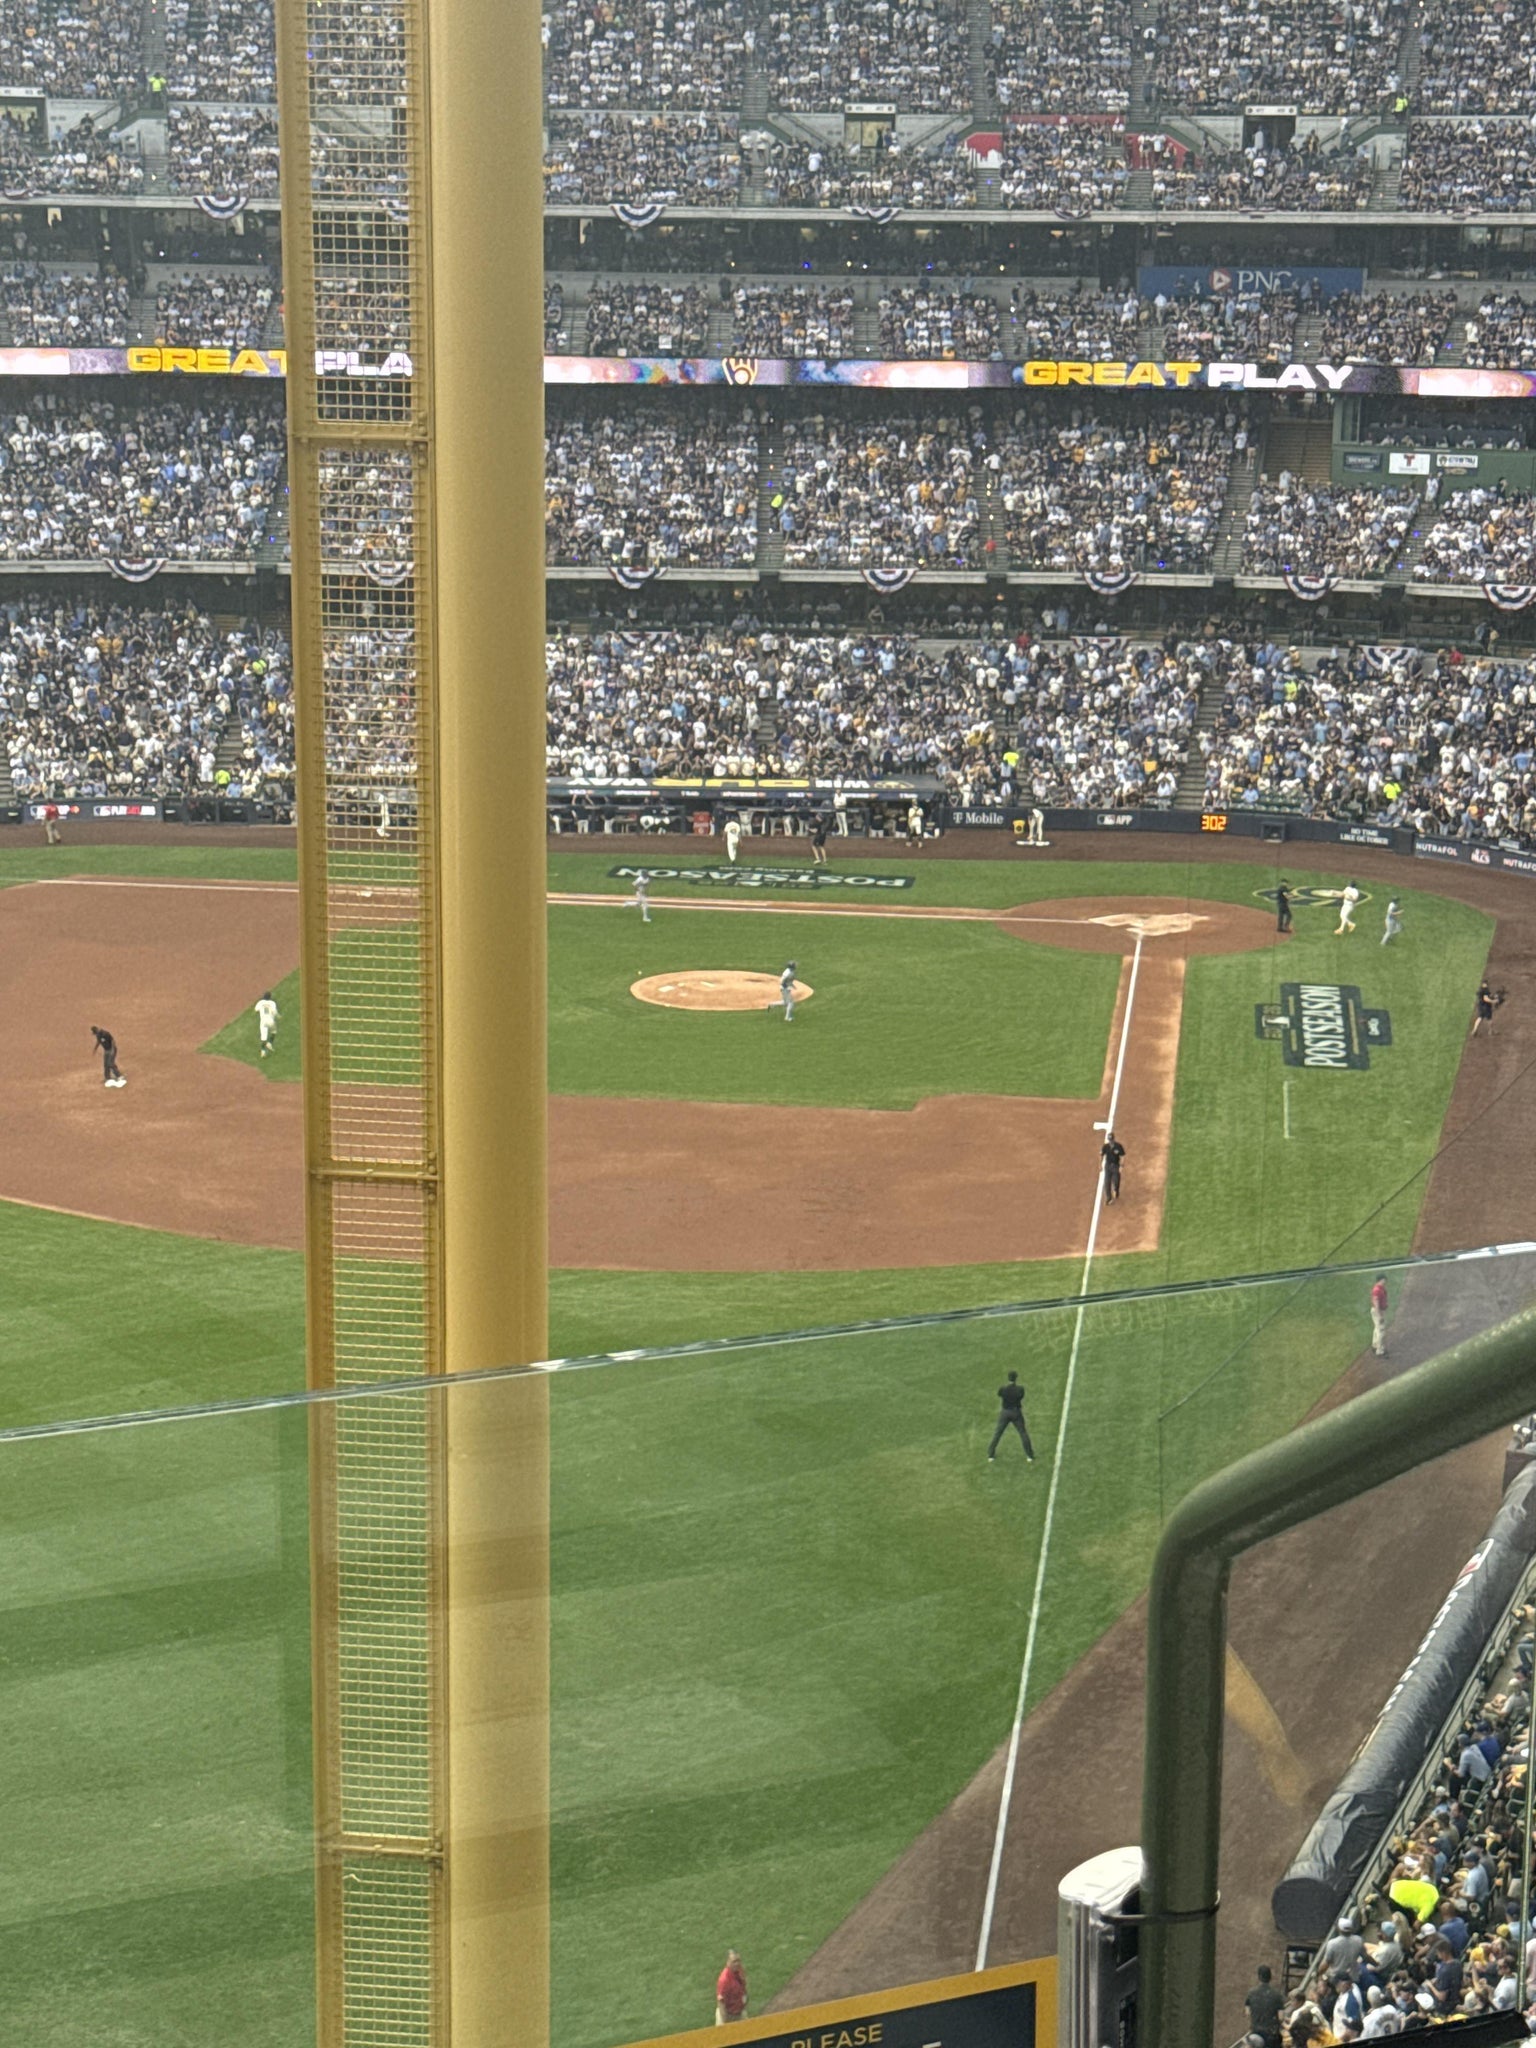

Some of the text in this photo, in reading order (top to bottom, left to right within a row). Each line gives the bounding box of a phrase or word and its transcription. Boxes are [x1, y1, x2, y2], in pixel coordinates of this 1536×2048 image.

[1237, 270, 1292, 291] PNC
[127, 347, 413, 376] GREAT PLA
[1023, 361, 1353, 389] GREAT PLAY
[965, 811, 1004, 825] Mobile
[1201, 815, 1227, 832] 302
[1416, 843, 1458, 856] NUTRAFOL
[1503, 858, 1536, 871] NUTRAFO
[616, 867, 906, 888] POSTSEASON
[1300, 984, 1348, 1068] POSTSEASON
